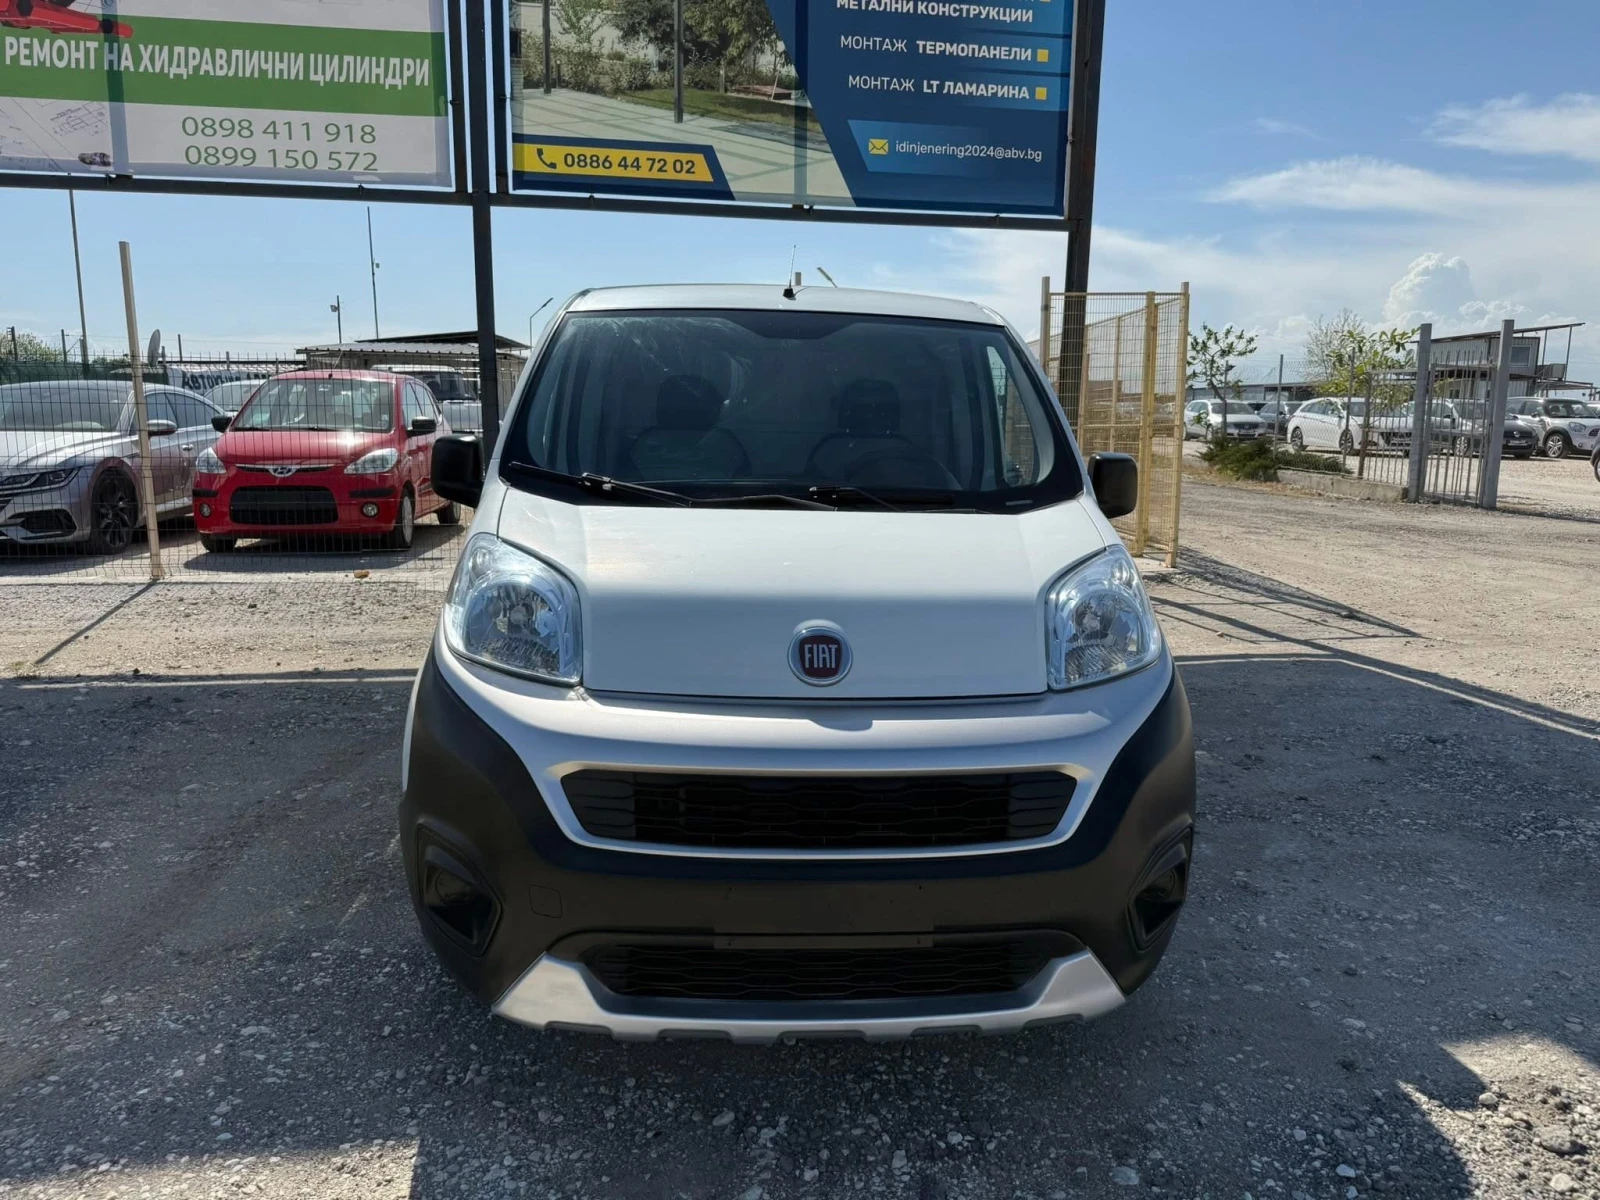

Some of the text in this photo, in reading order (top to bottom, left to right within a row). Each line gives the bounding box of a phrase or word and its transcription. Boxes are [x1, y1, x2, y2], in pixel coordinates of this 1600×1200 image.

[836, 0, 1033, 23] МЕТАЛНИ КОНСТРУКЦИИ
[840, 35, 1032, 61] МОНТАЖ ТЕРМОПАНЕЛИ
[5, 36, 430, 90] РЕМОНТ НА ХИДРАВЛИЧНИ ЦИЛИНДРИ
[848, 75, 1030, 99] МОНТАЖ LT ЛАМАРИНА
[181, 116, 376, 144] 0898 411 918
[184, 145, 378, 172] 0899 150 572
[563, 152, 696, 174] 0886 44 72 02
[895, 140, 1042, 162] idinjenering2024@abv.bg
[804, 643, 838, 668] FIAT
